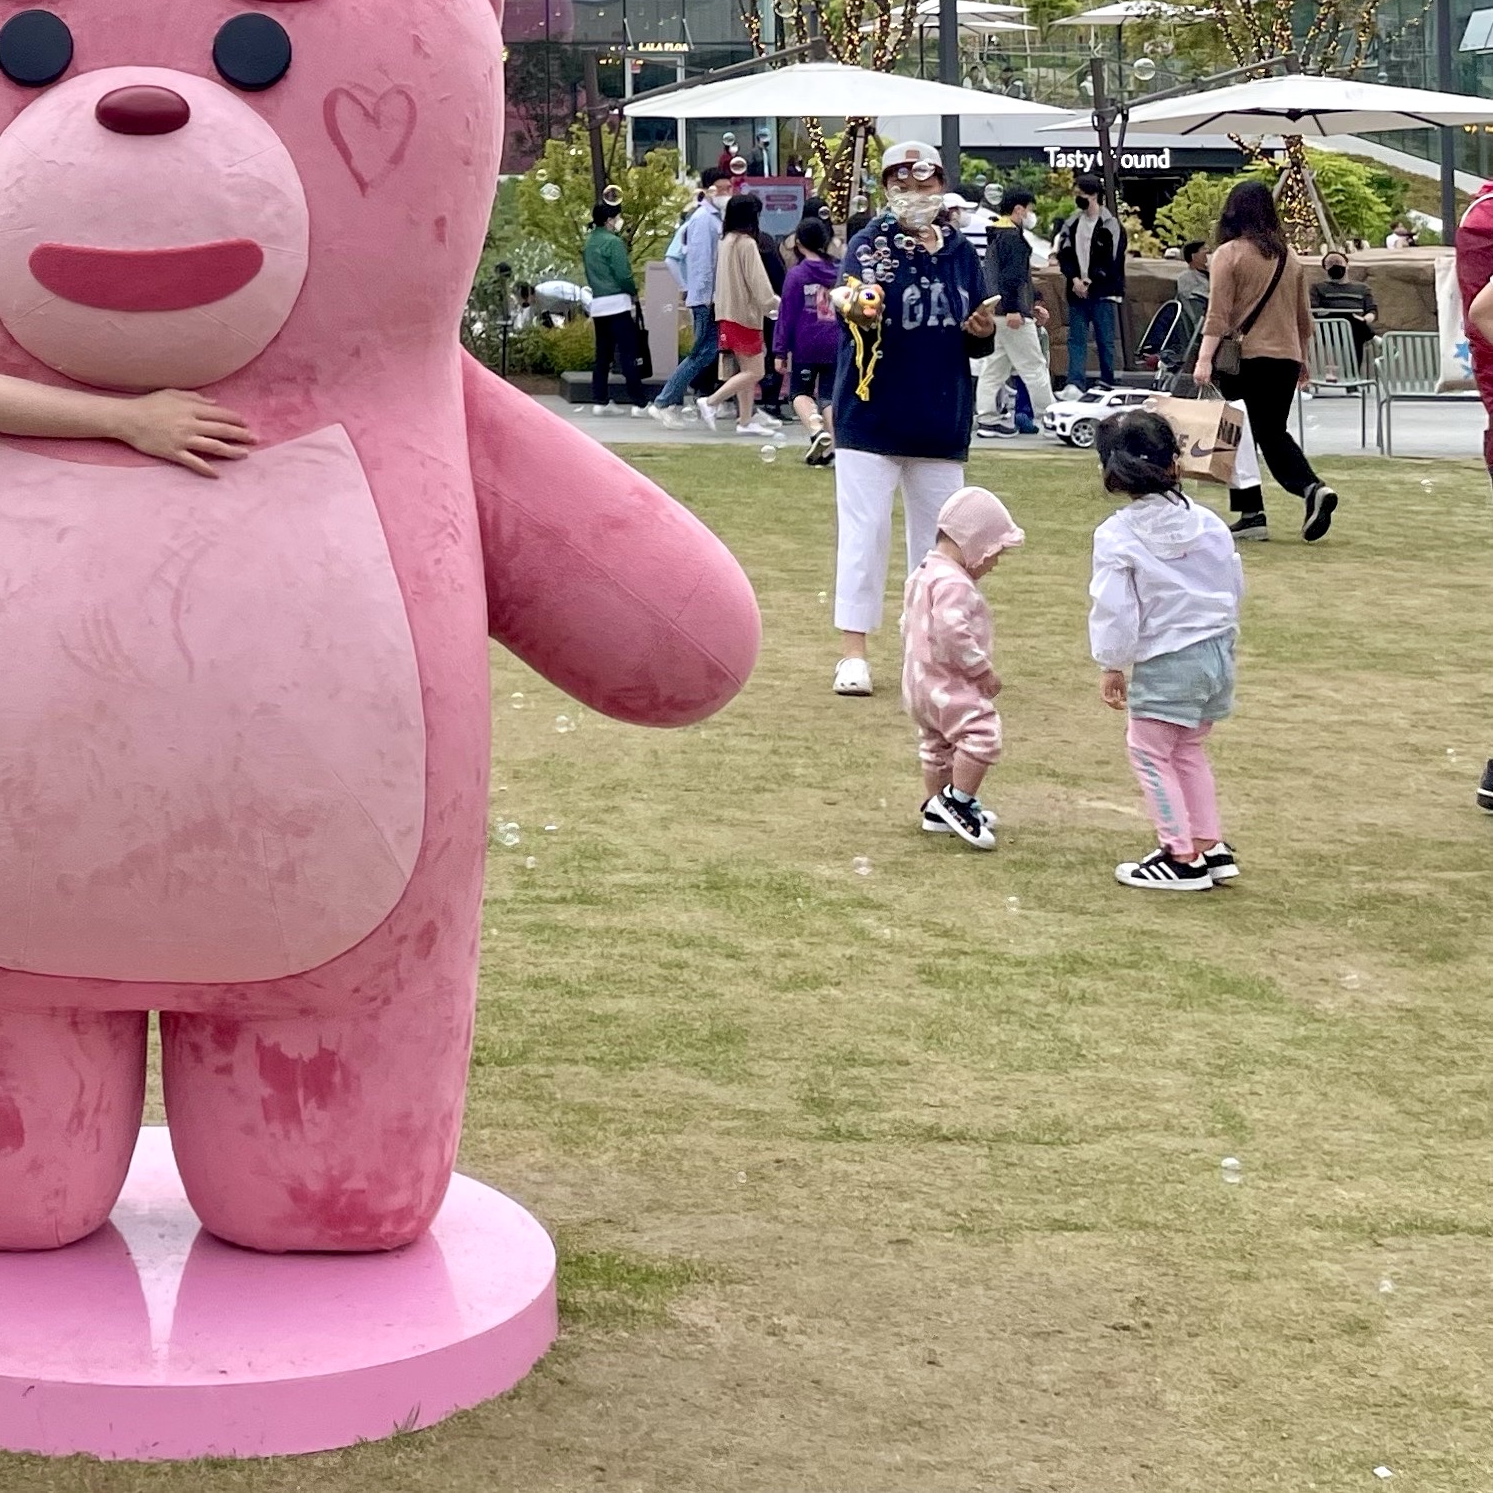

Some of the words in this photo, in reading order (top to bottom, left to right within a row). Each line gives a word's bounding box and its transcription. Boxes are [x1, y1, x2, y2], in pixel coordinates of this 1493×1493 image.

[638, 42, 663, 52] LALA
[1043, 147, 1095, 172] Tasty
[1096, 147, 1170, 168] ound
